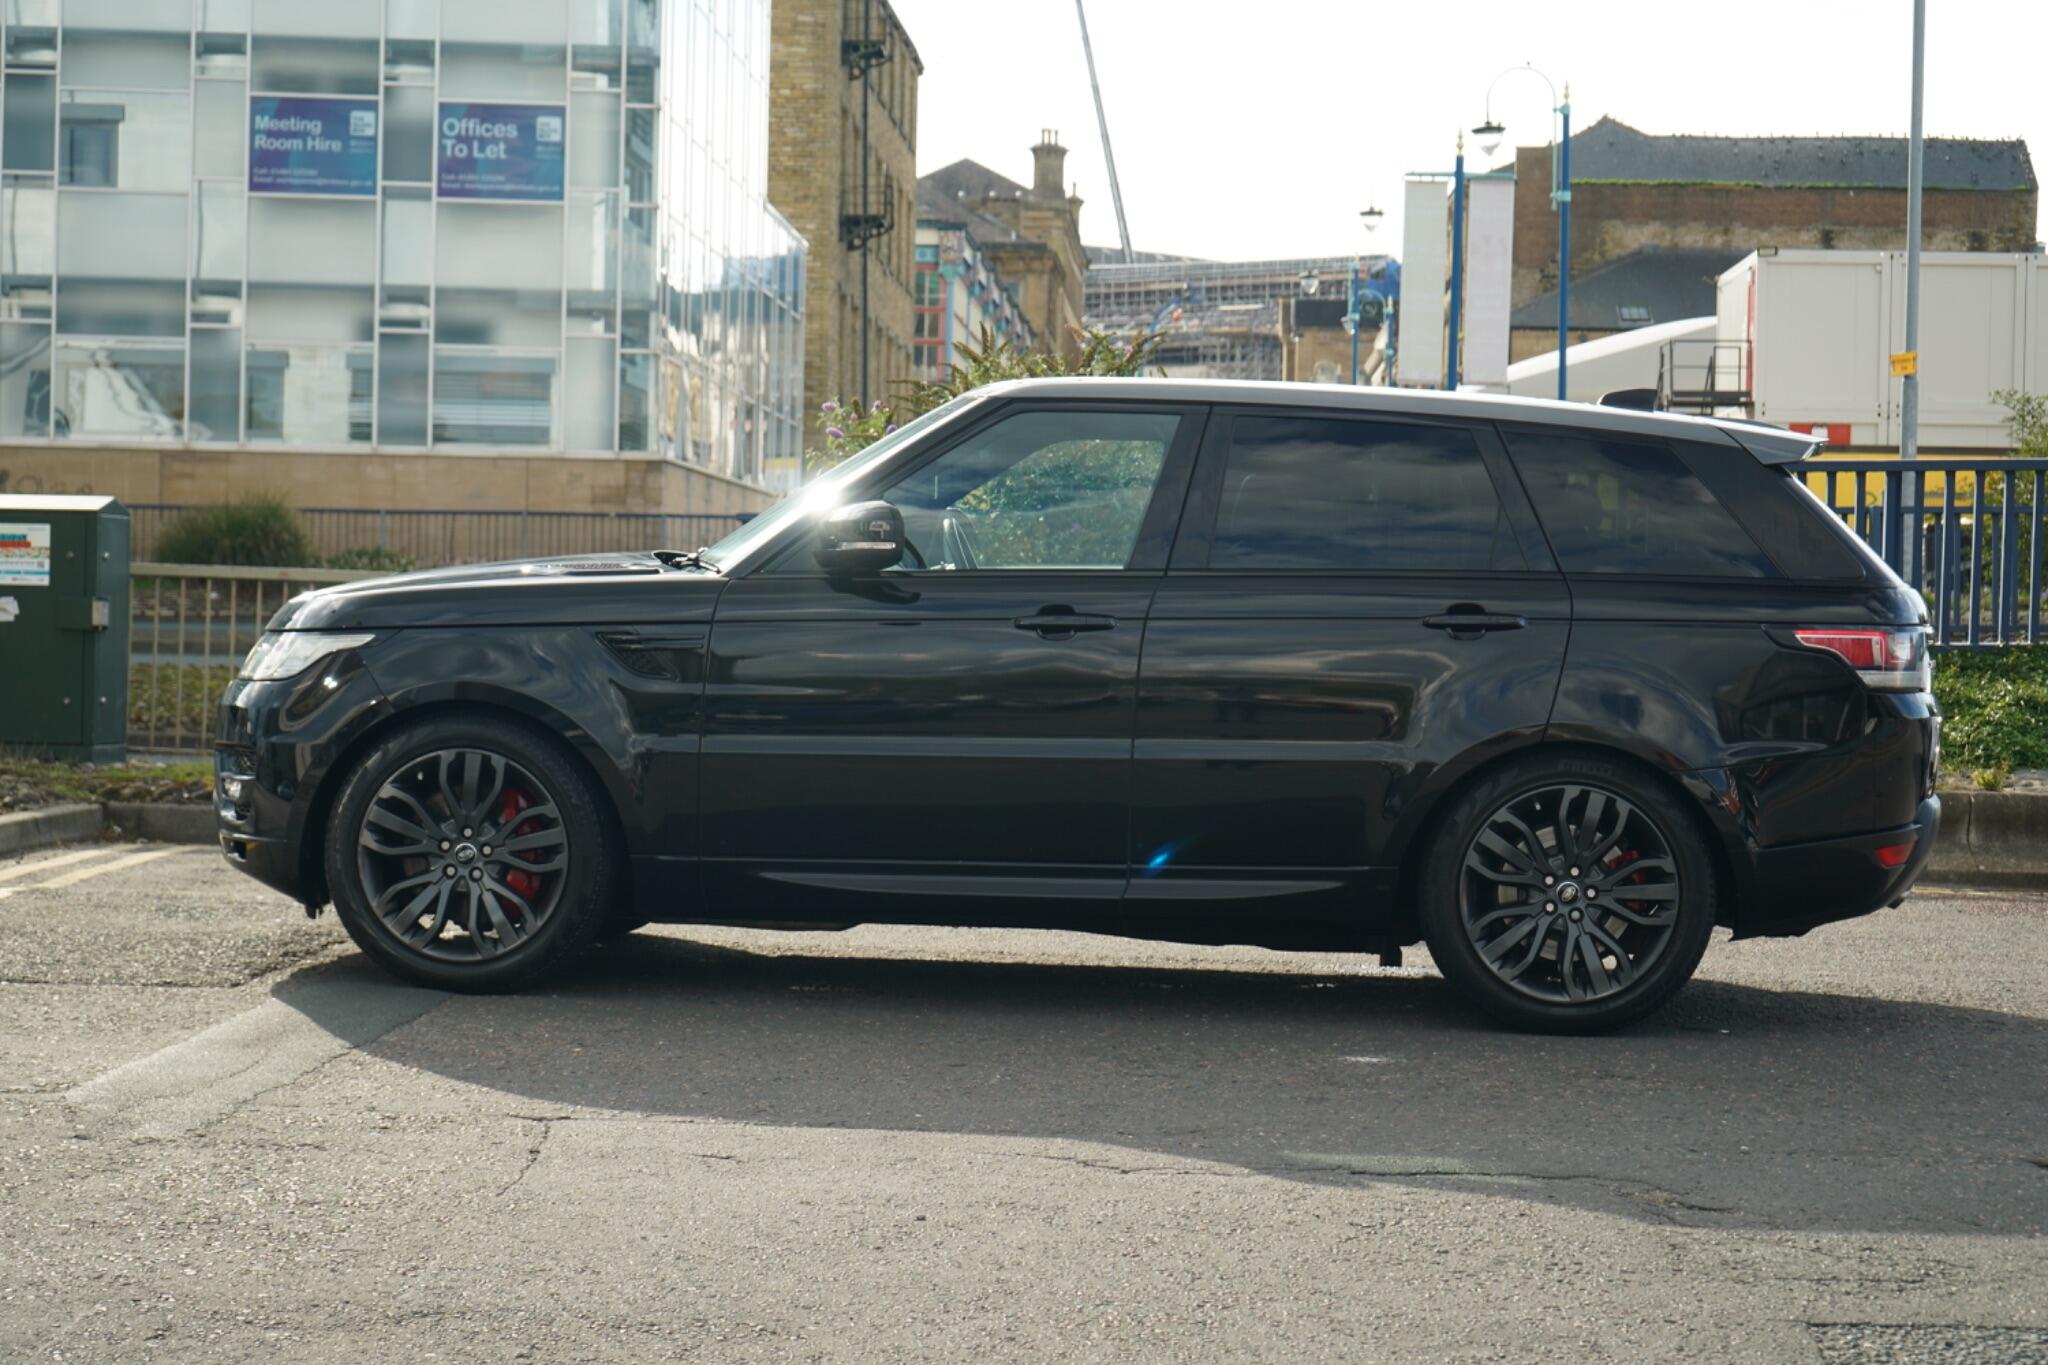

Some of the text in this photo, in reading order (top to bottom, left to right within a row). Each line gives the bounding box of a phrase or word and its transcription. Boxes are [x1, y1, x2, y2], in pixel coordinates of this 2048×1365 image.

[255, 115, 322, 135] Meeting
[442, 117, 518, 138] Offices
[255, 135, 303, 151] Room
[307, 137, 342, 152] Hire
[443, 139, 507, 160] To Let
